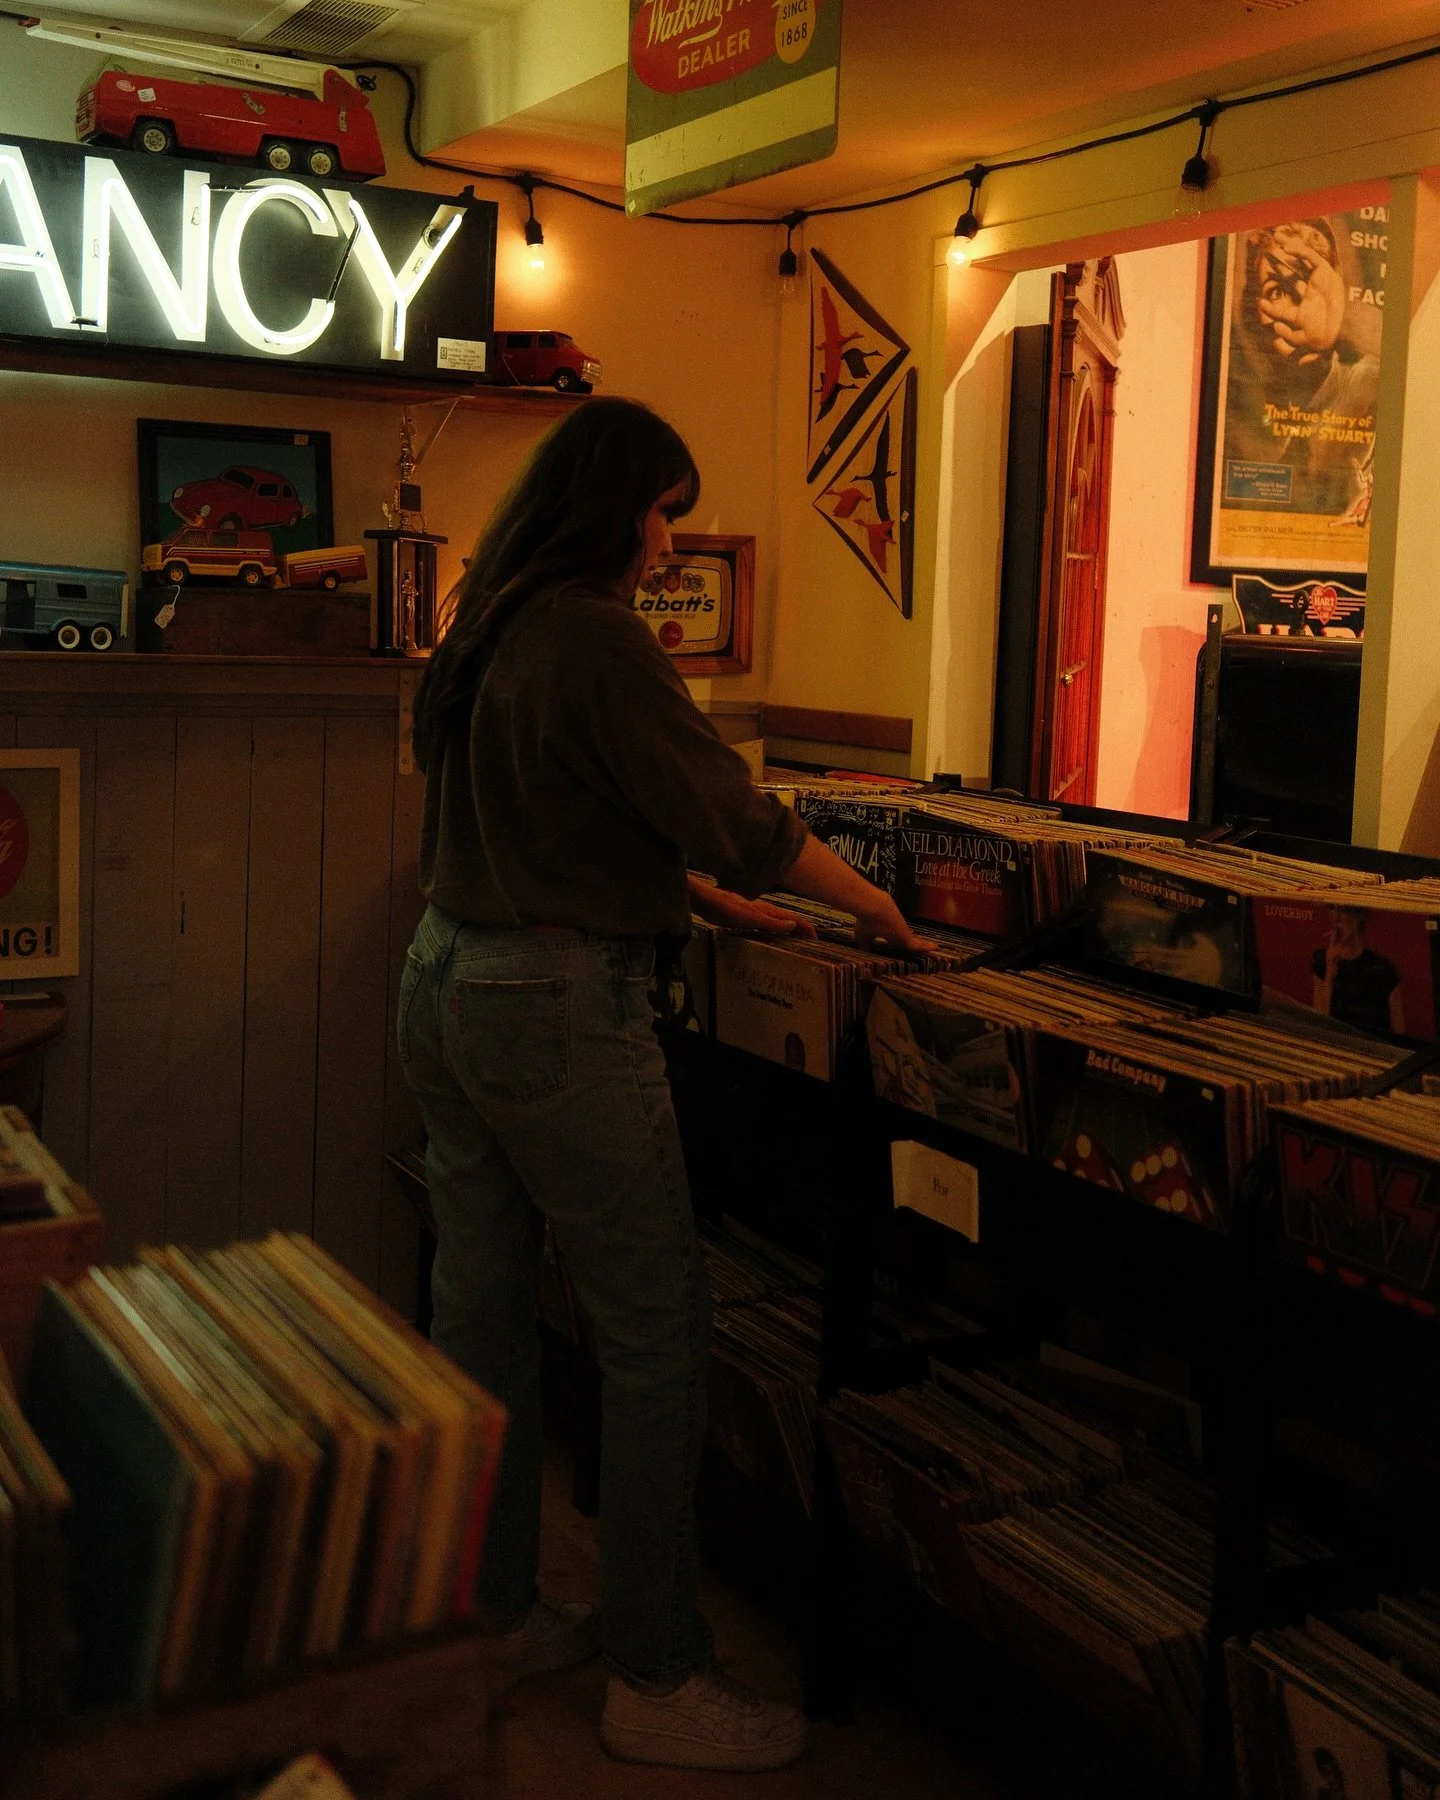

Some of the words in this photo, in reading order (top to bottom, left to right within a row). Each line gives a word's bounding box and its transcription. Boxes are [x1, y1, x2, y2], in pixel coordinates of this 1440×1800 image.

[782, 0, 808, 21] SINCE
[781, 22, 808, 48] 1868
[677, 27, 751, 79] DEALER
[0, 145, 467, 361] ANCY
[1264, 402, 1287, 420] The
[1288, 400, 1319, 422] True
[1321, 408, 1356, 428] Story
[1358, 415, 1373, 428] of
[1271, 422, 1312, 438] LYNN
[1318, 426, 1376, 444] STUART
[632, 594, 716, 612] abatt's
[900, 831, 935, 855] NEIL
[937, 834, 1013, 863] DIAMOND
[939, 861, 951, 877] at
[952, 857, 968, 879] the
[969, 861, 1002, 885] Greek
[1264, 904, 1314, 921] LOVERBOY
[1086, 1048, 1112, 1072] Bad
[1111, 1056, 1168, 1095] Company
